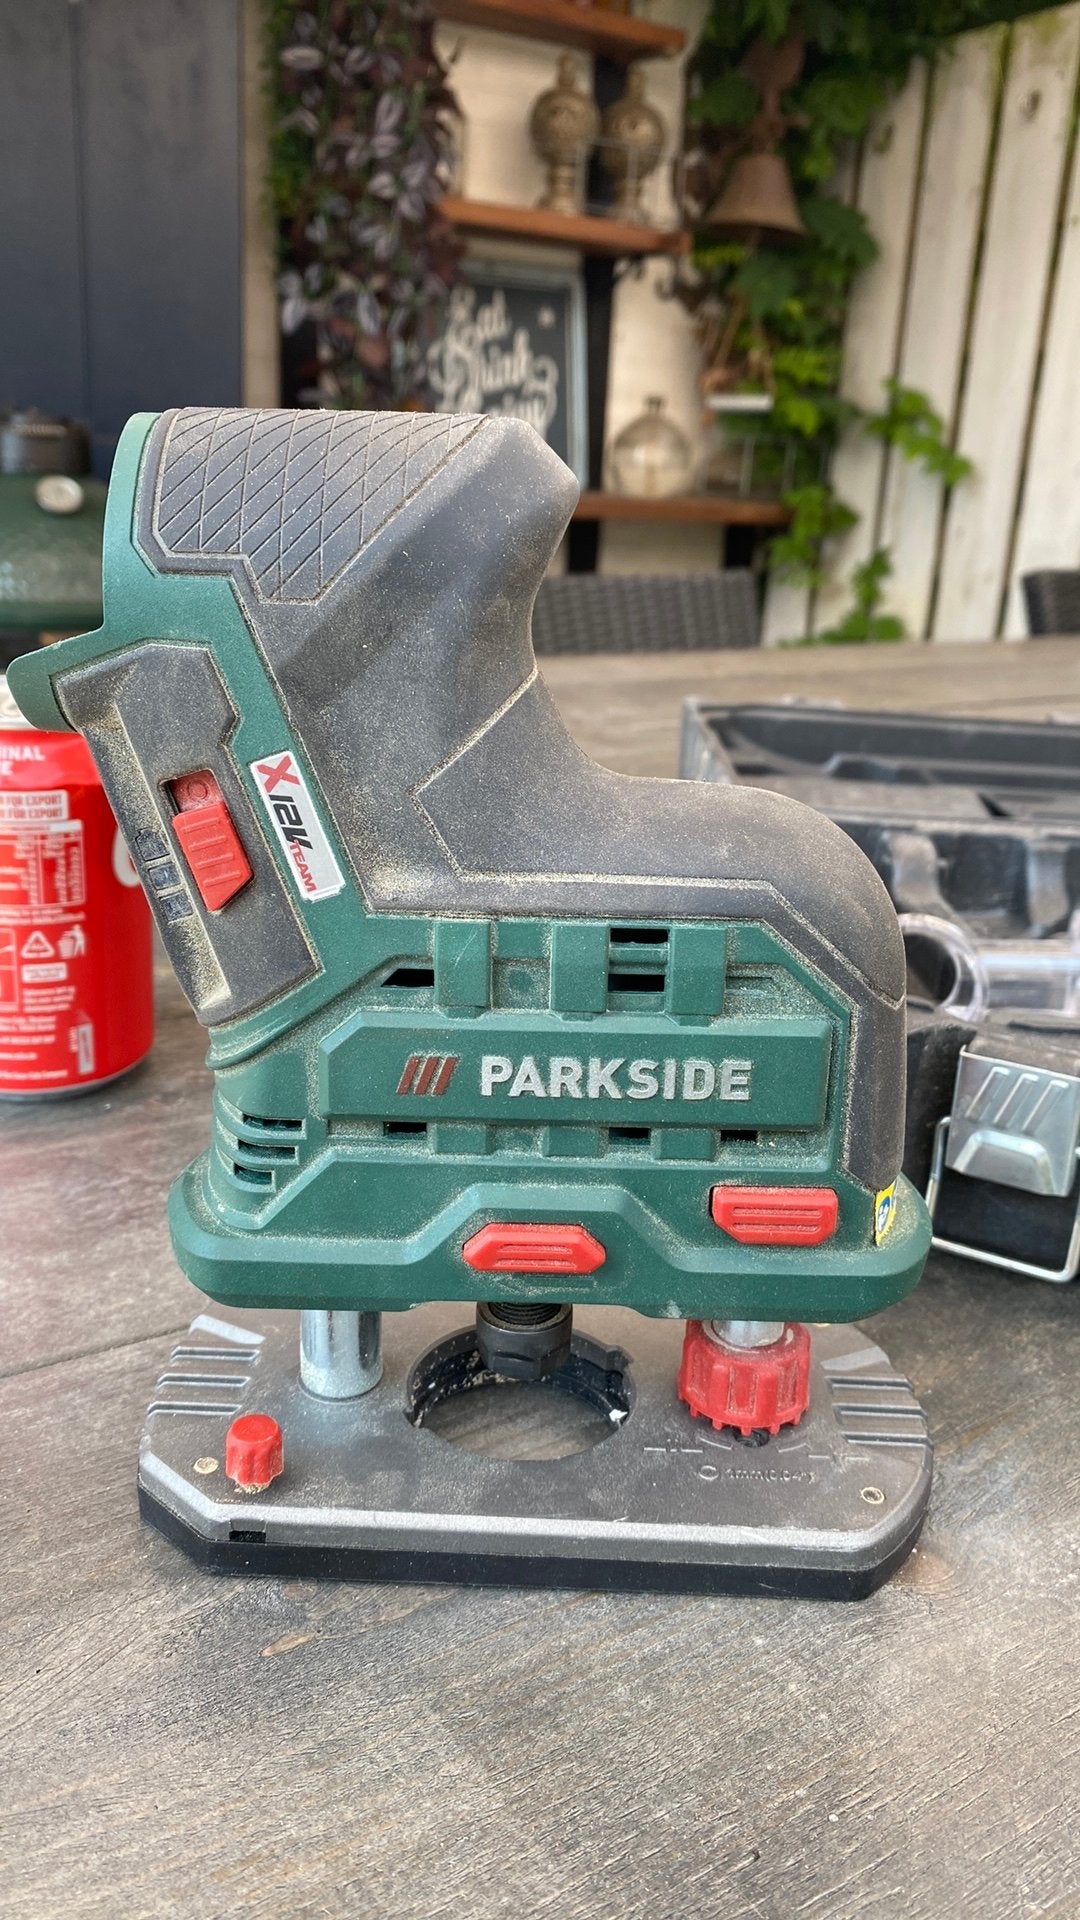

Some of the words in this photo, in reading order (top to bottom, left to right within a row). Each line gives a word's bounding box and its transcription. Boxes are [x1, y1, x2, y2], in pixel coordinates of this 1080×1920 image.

[0, 744, 46, 761] INAL
[0, 760, 13, 776] E
[256, 755, 301, 793] X
[269, 794, 313, 850] 12V
[288, 839, 317, 893] TEAM
[481, 1055, 752, 1101] PARKSIDE
